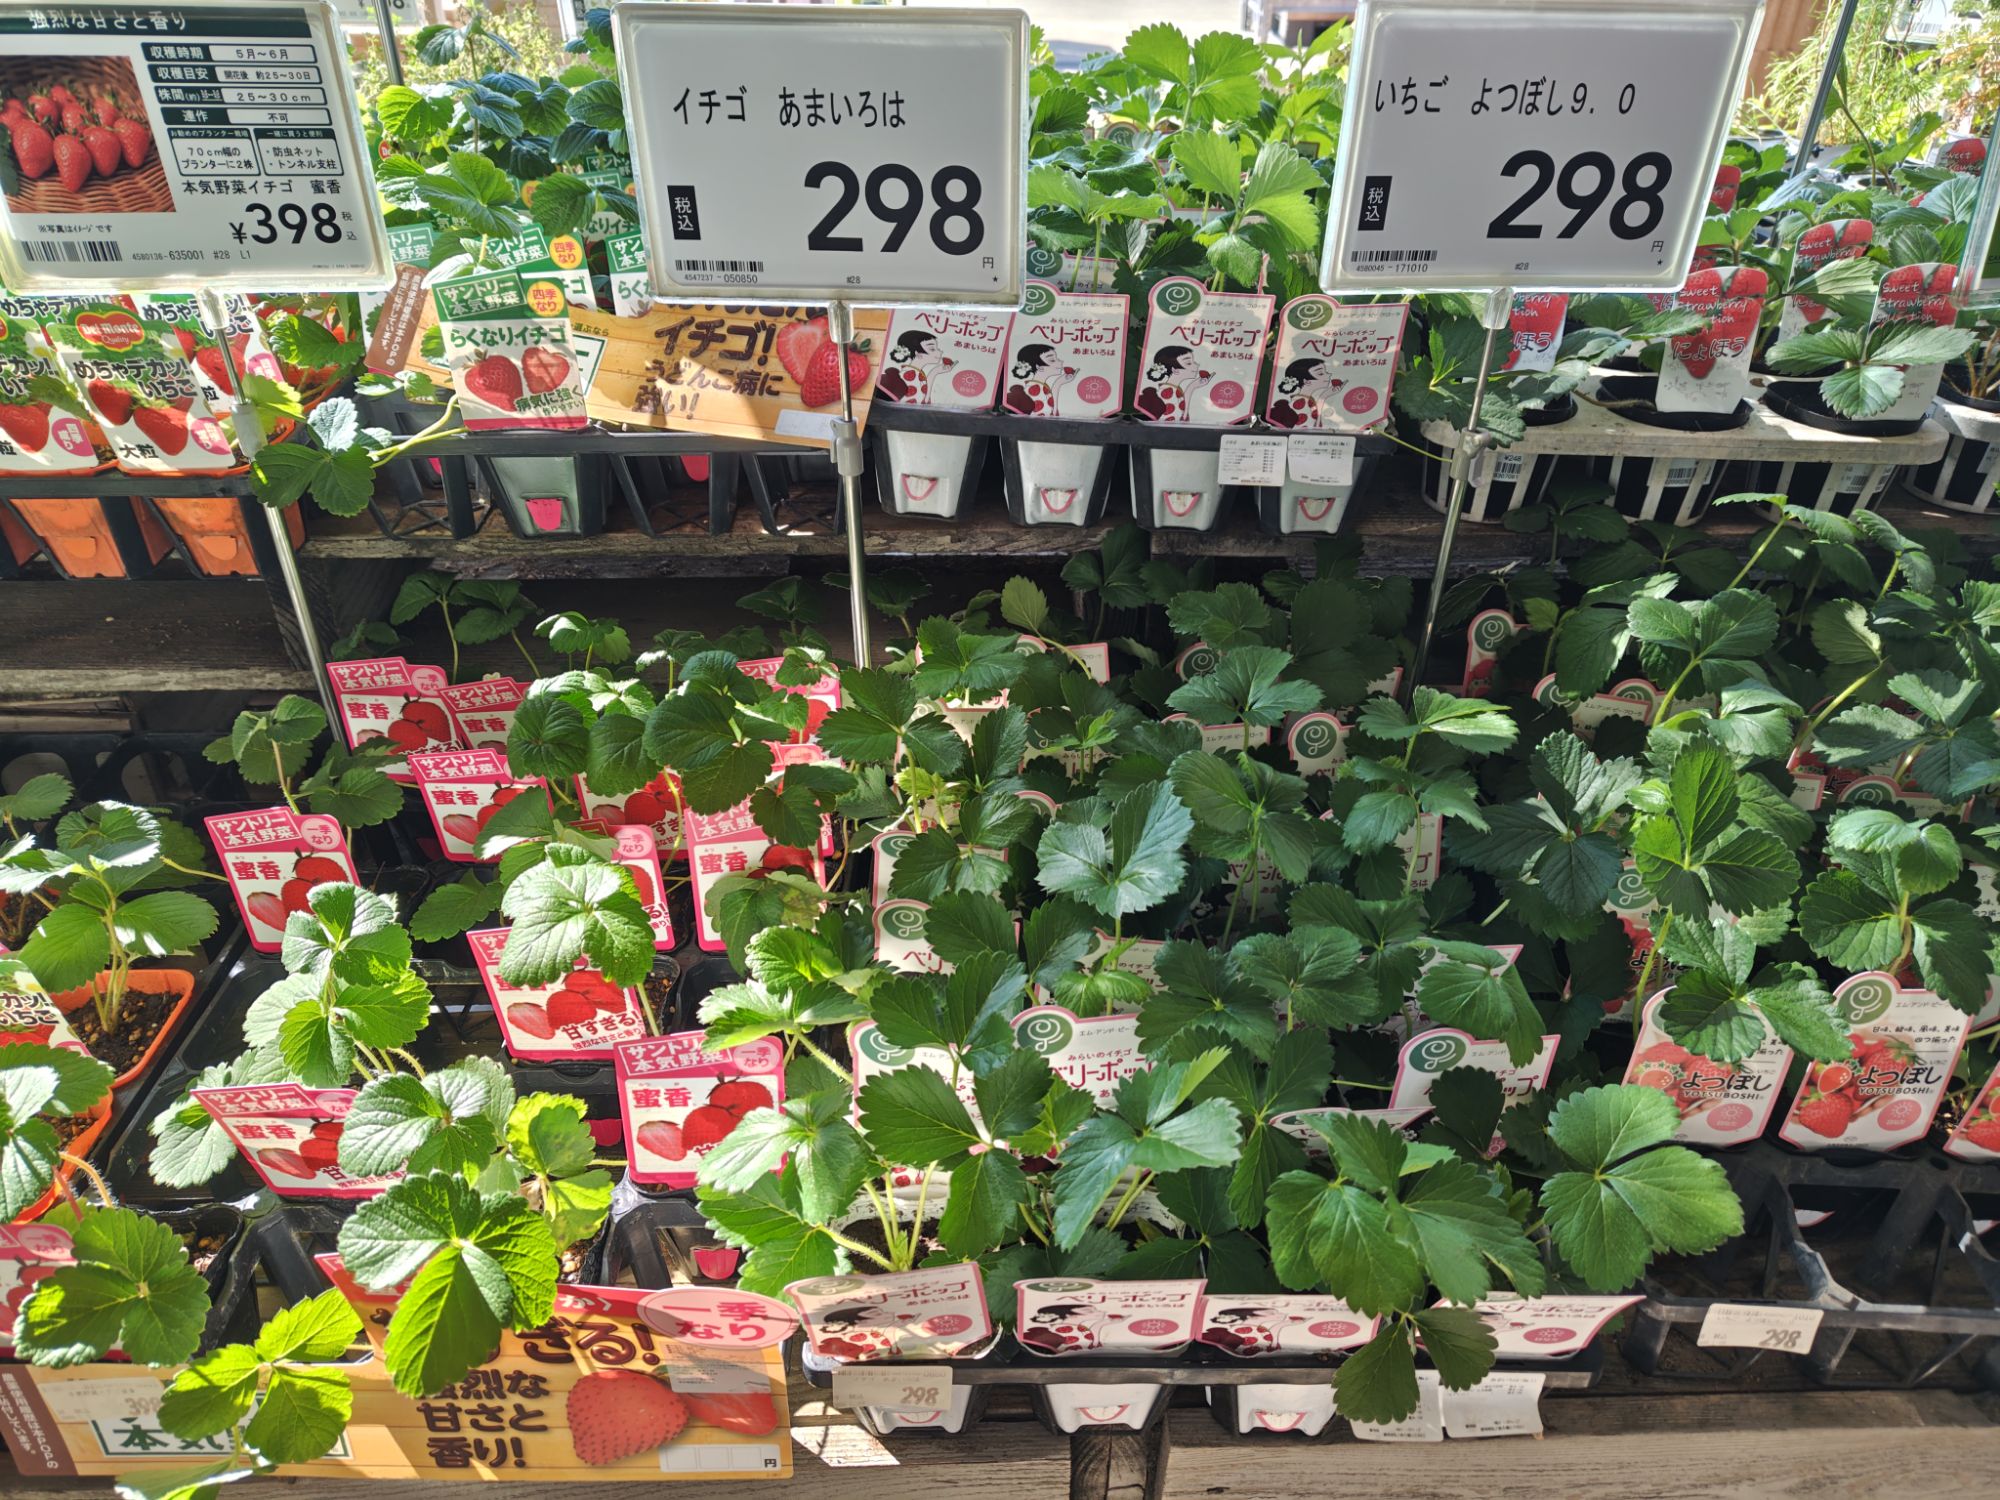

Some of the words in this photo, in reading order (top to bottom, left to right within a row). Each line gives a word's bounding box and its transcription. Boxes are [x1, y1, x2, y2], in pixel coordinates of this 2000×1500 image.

[28, 9, 187, 31] 強烈な甘さと香り
[150, 46, 204, 60] 収穫時期
[157, 66, 209, 80] 収穫目安
[1375, 75, 1449, 115] いちご
[182, 109, 209, 122] 連作
[673, 86, 747, 125] イチゴ
[778, 86, 906, 129] あまいろは
[268, 112, 289, 123] 不可
[182, 180, 293, 195] 本気野菜イチゴ
[310, 179, 341, 194] 蜜香
[1486, 150, 1673, 241] 298
[803, 160, 985, 256] 298
[1365, 187, 1383, 223] 税込
[674, 196, 695, 232] 税込
[554, 241, 576, 252] 四季
[1650, 240, 1664, 253] 円
[1799, 238, 1833, 250] Sweet
[557, 252, 577, 263] なり
[982, 257, 995, 269] 円
[1796, 248, 1857, 265] Strawberry
[442, 280, 514, 300] サントリー
[532, 288, 557, 300] 四季
[1679, 285, 1719, 297] Sweet
[1882, 282, 1920, 293] Sweet
[451, 290, 520, 316] 本気野菜
[536, 299, 558, 312] なり
[1878, 297, 1946, 310] Strawberry
[914, 311, 1005, 342] ベリーポップ
[1192, 319, 1244, 327] みらいのイチゴ
[450, 323, 567, 348] らくなりイチゴ
[1030, 325, 1120, 344] ベリーポップ
[1170, 326, 1262, 348] ベリーポップ
[1324, 328, 1377, 337] みらいのイチゴ
[655, 316, 777, 366] イチゴ!
[953, 340, 998, 354] あまいろは
[1301, 336, 1395, 356] ベリーポップ
[1072, 347, 1116, 357] あまいろは
[1210, 350, 1254, 361] あまいろは
[1673, 338, 1745, 362] にょほう
[74, 357, 195, 380] めちゃデカッ!
[1342, 358, 1387, 367] あまいろは
[645, 359, 784, 397] うどんこ病に
[138, 378, 198, 399] いちご
[516, 385, 583, 411] 病気に強く
[119, 443, 160, 459] 大粒
[336, 664, 400, 677] サントリー
[343, 673, 409, 688] 本気野菜
[447, 684, 510, 698] サントリー
[456, 692, 521, 708] 本気野菜
[347, 702, 390, 720] 蜜香
[463, 717, 506, 733] 蜜香
[419, 755, 492, 769] サントリー
[427, 763, 499, 778] 本気野菜
[431, 788, 480, 805] 蜜香
[216, 814, 287, 833] サントリー
[306, 824, 332, 836] 一季
[224, 824, 297, 846] 本気野菜
[310, 834, 333, 846] なり
[619, 833, 644, 844] 一季
[622, 843, 644, 854] なり
[234, 860, 281, 881] 蜜香
[699, 851, 748, 875] 蜜香
[562, 1010, 644, 1040] 甘すぎる!
[631, 1048, 725, 1072] 本気野菜
[741, 1046, 771, 1058] 一季
[1068, 1049, 1133, 1061] みらいのイチゴ
[744, 1057, 769, 1067] なり
[1682, 1071, 1773, 1092] よつぼし
[1858, 1066, 1942, 1086] よつぼし
[207, 1089, 296, 1104] サントリー
[632, 1087, 692, 1108] 蜜香
[1683, 1090, 1760, 1100] YOTSUBOSHI
[1858, 1087, 1930, 1095] YOTSUBOSHI
[219, 1098, 310, 1114] 本気野菜
[233, 1124, 296, 1140] 蜜香
[663, 1301, 769, 1322] 一季
[676, 1320, 767, 1342] なり
[1758, 1328, 1803, 1350] 298
[431, 1370, 550, 1400] 烈な
[900, 1385, 940, 1406] 298
[417, 1402, 548, 1433] 甘さと
[427, 1437, 527, 1469] 香り!
